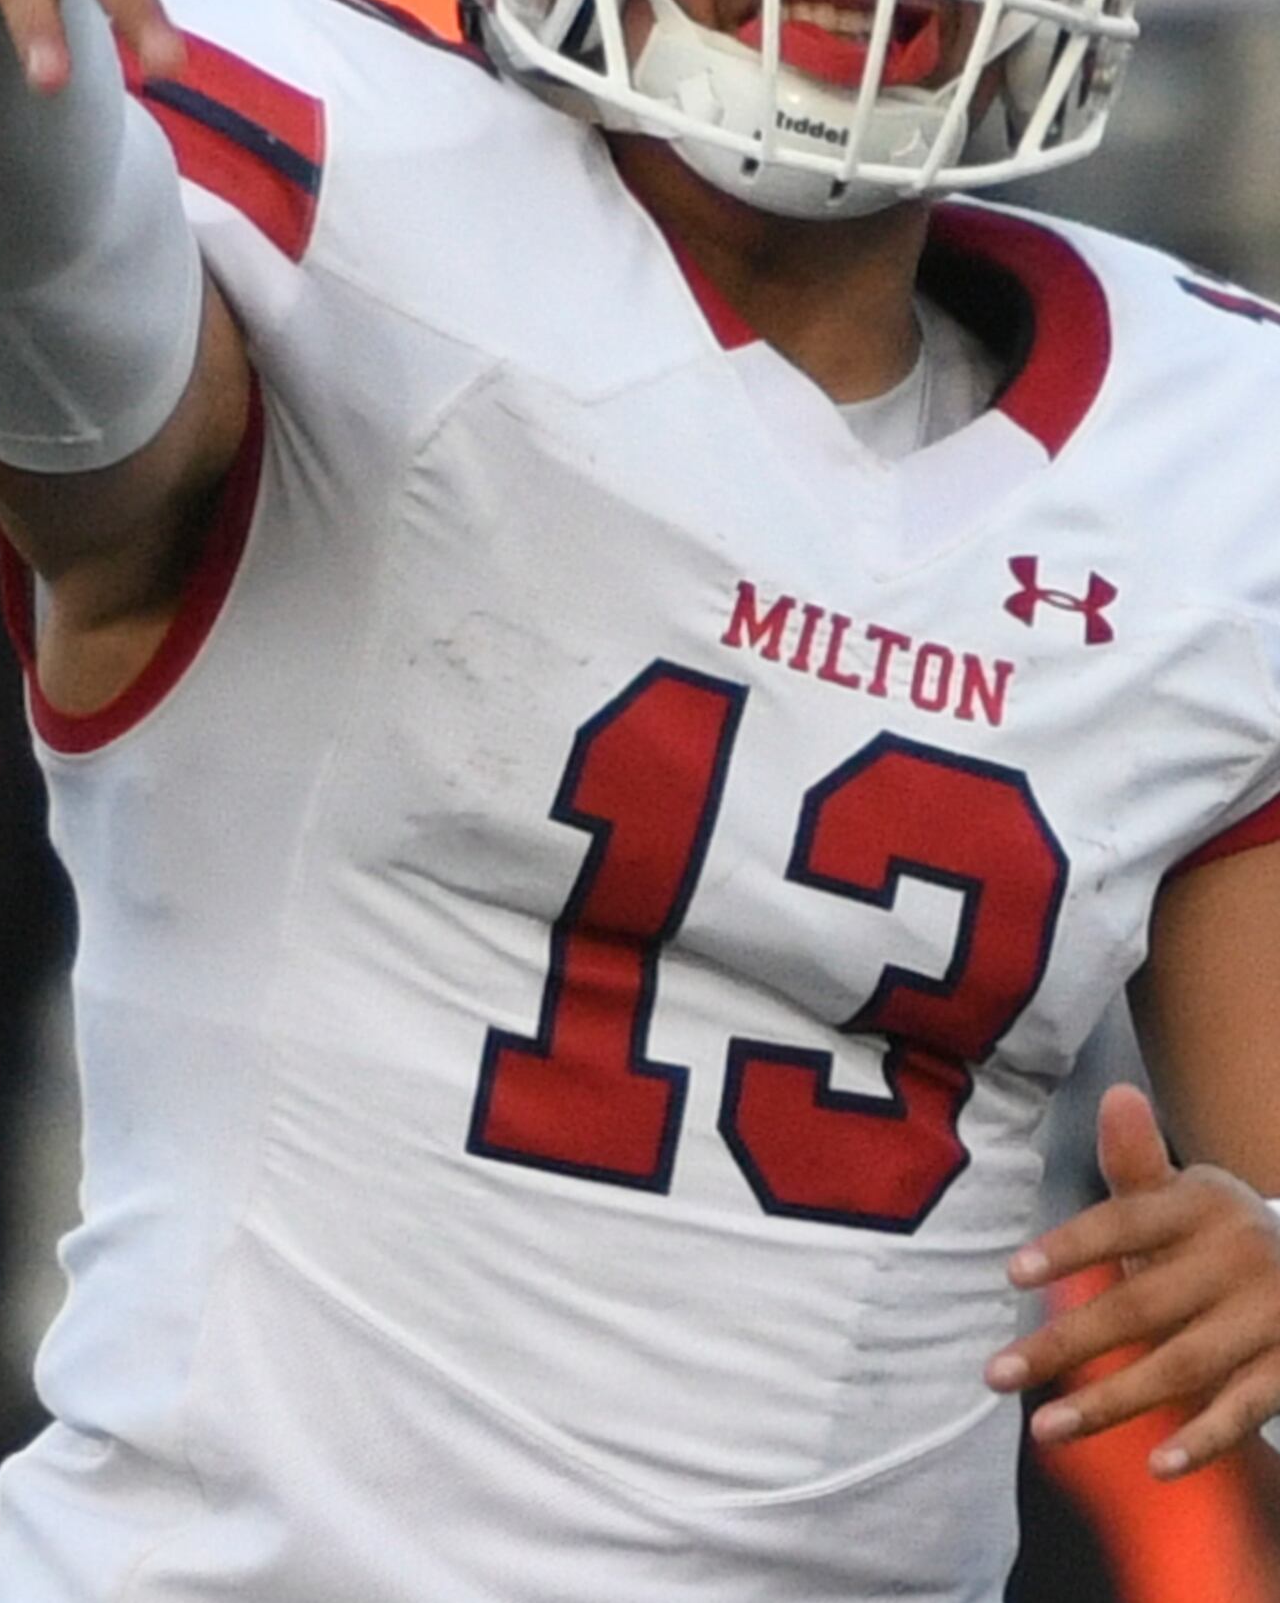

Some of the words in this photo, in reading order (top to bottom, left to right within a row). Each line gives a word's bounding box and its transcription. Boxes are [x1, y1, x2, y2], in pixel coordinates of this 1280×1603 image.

[776, 109, 850, 147] iddel
[721, 580, 1014, 726] MILTON
[466, 657, 1070, 1236] 13
